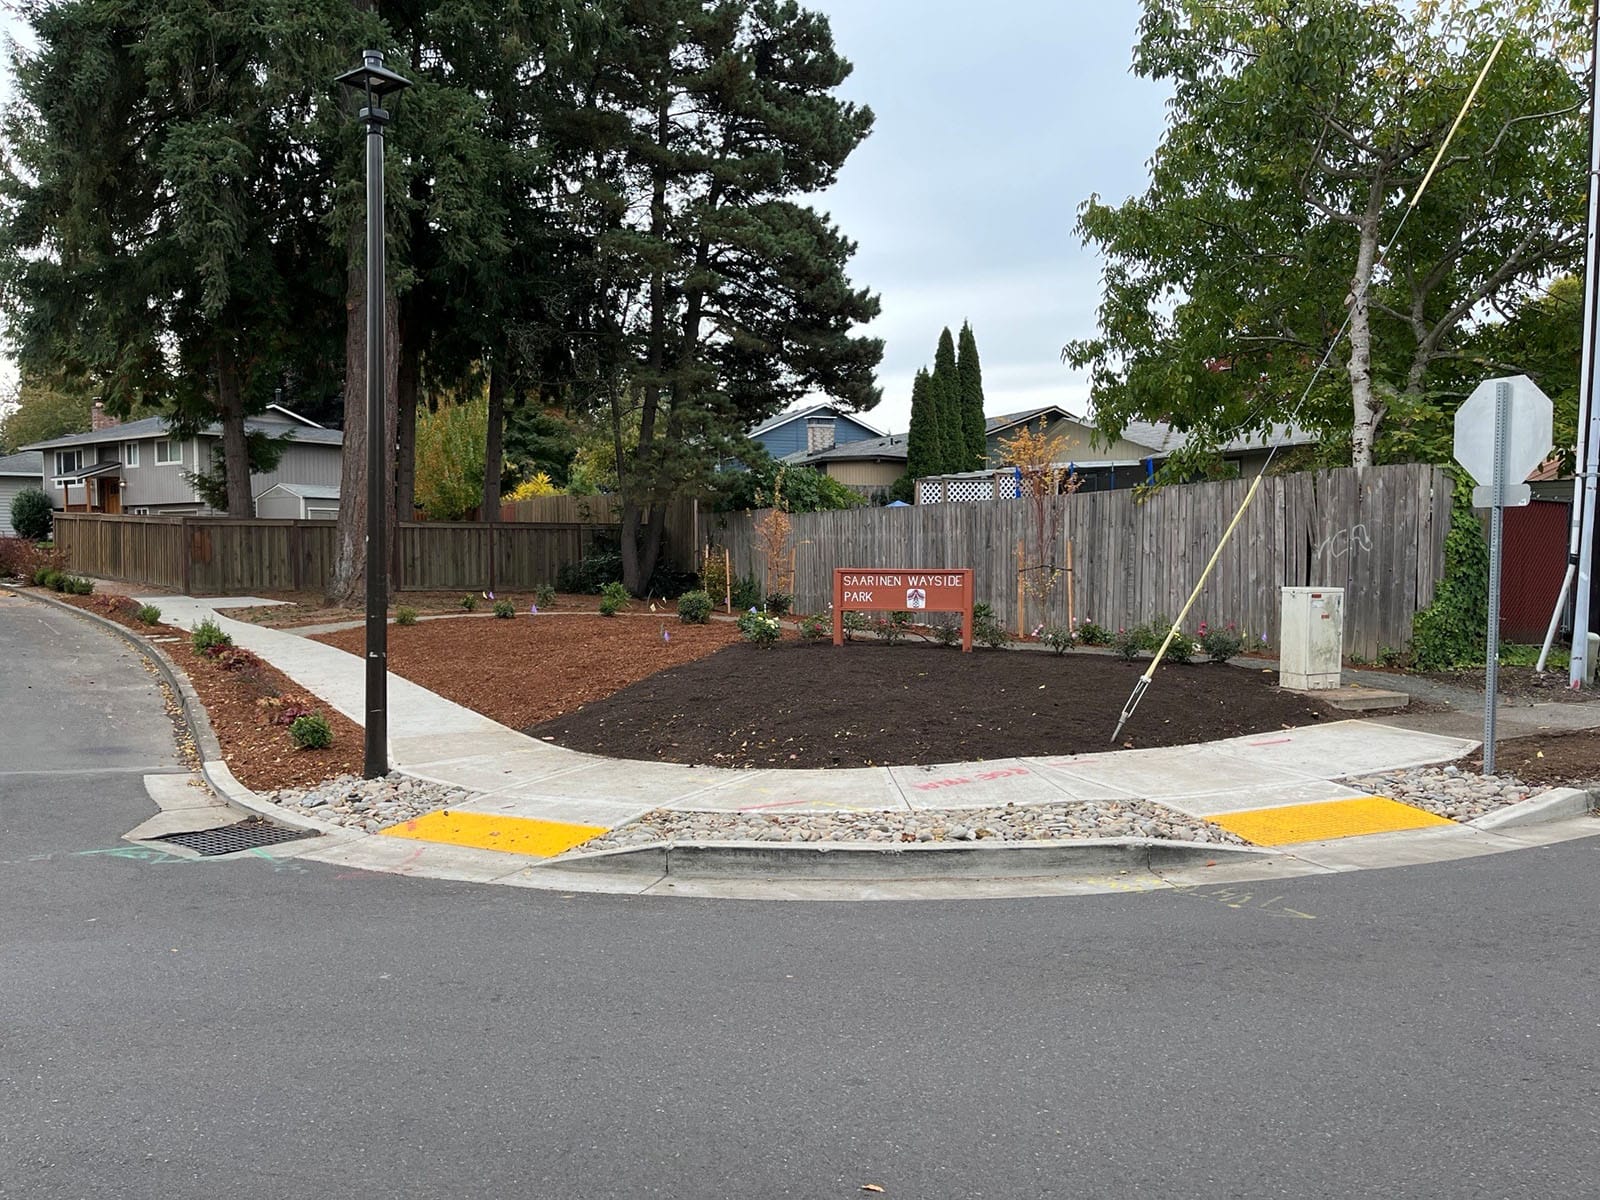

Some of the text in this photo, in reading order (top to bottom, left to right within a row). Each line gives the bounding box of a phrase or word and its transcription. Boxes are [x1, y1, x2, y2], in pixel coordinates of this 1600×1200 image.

[843, 575, 963, 587] SAARINEN WAYSIDE
[844, 591, 873, 602] PARK
